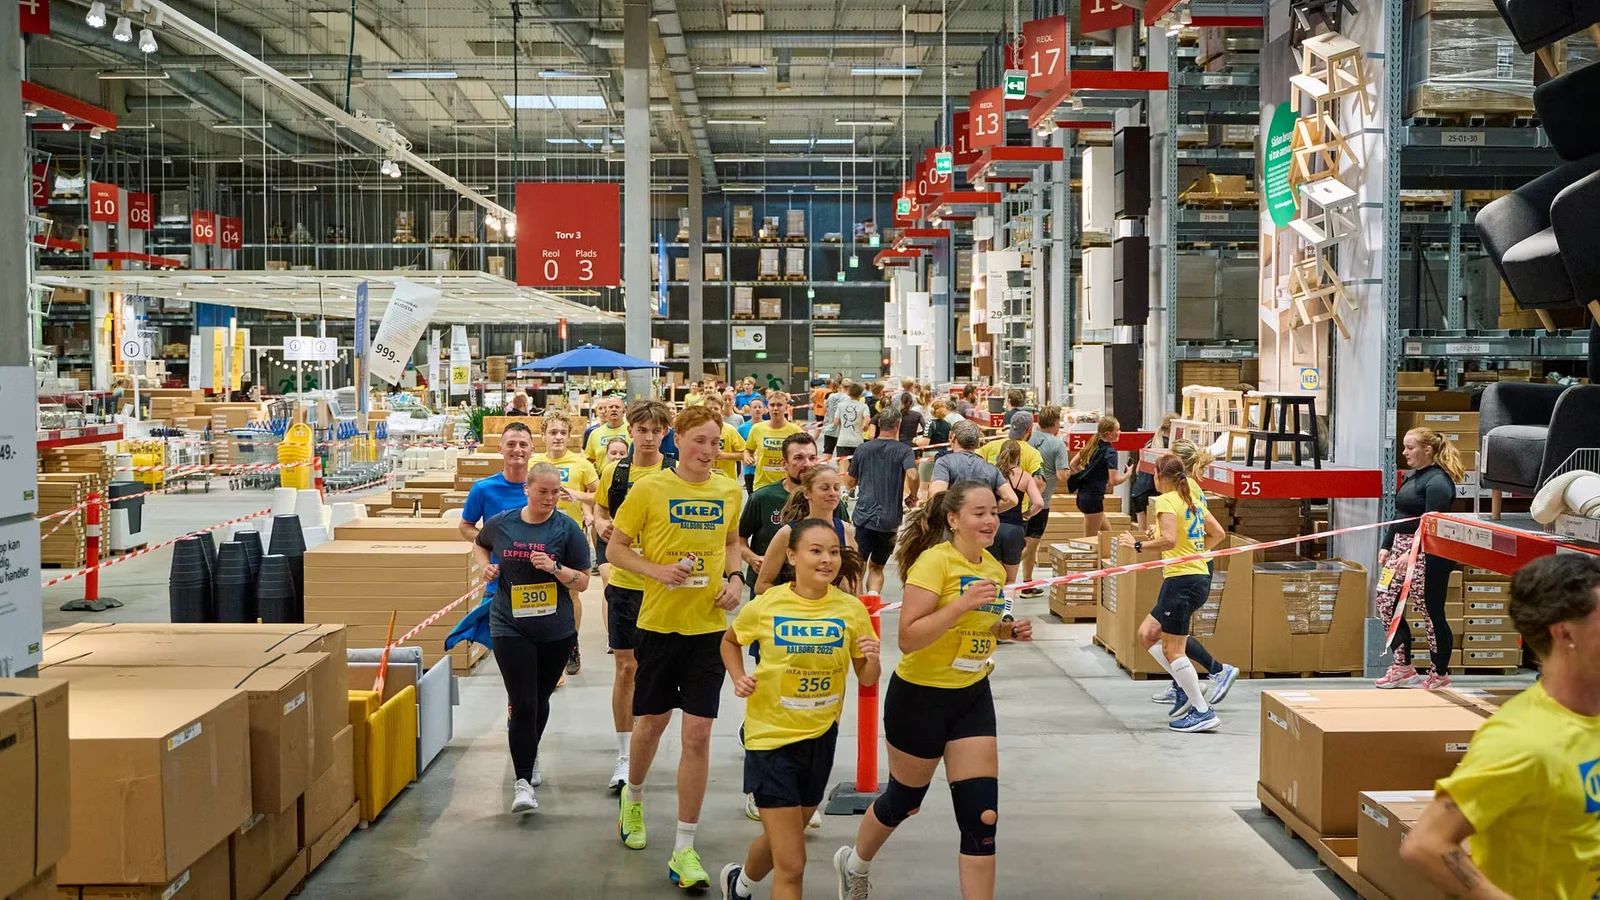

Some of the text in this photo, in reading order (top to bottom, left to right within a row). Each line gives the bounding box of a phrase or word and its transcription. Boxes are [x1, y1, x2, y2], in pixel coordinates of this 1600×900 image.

[1036, 35, 1053, 43] REOL
[1031, 48, 1060, 77] 17
[975, 113, 999, 135] 13
[929, 168, 948, 184] 09
[94, 200, 115, 215] 10
[131, 208, 150, 222] 08
[195, 224, 213, 237] 06
[223, 231, 239, 243] 04
[575, 250, 597, 258] Plads
[544, 259, 593, 281] 0 3
[375, 344, 401, 363] 999.-
[1302, 375, 1317, 384] IKEA
[1074, 440, 1086, 449] 21
[1241, 482, 1260, 495] 25
[676, 506, 720, 516] IKEA
[8, 540, 20, 551] kan
[528, 543, 545, 551] THE
[503, 550, 555, 559] EXPERE
[5, 567, 29, 582] handler
[522, 591, 547, 604] 390
[781, 625, 840, 638] IKEA
[786, 645, 834, 654] AALBORG 2025
[970, 639, 990, 654] 359
[798, 677, 831, 692] 356
